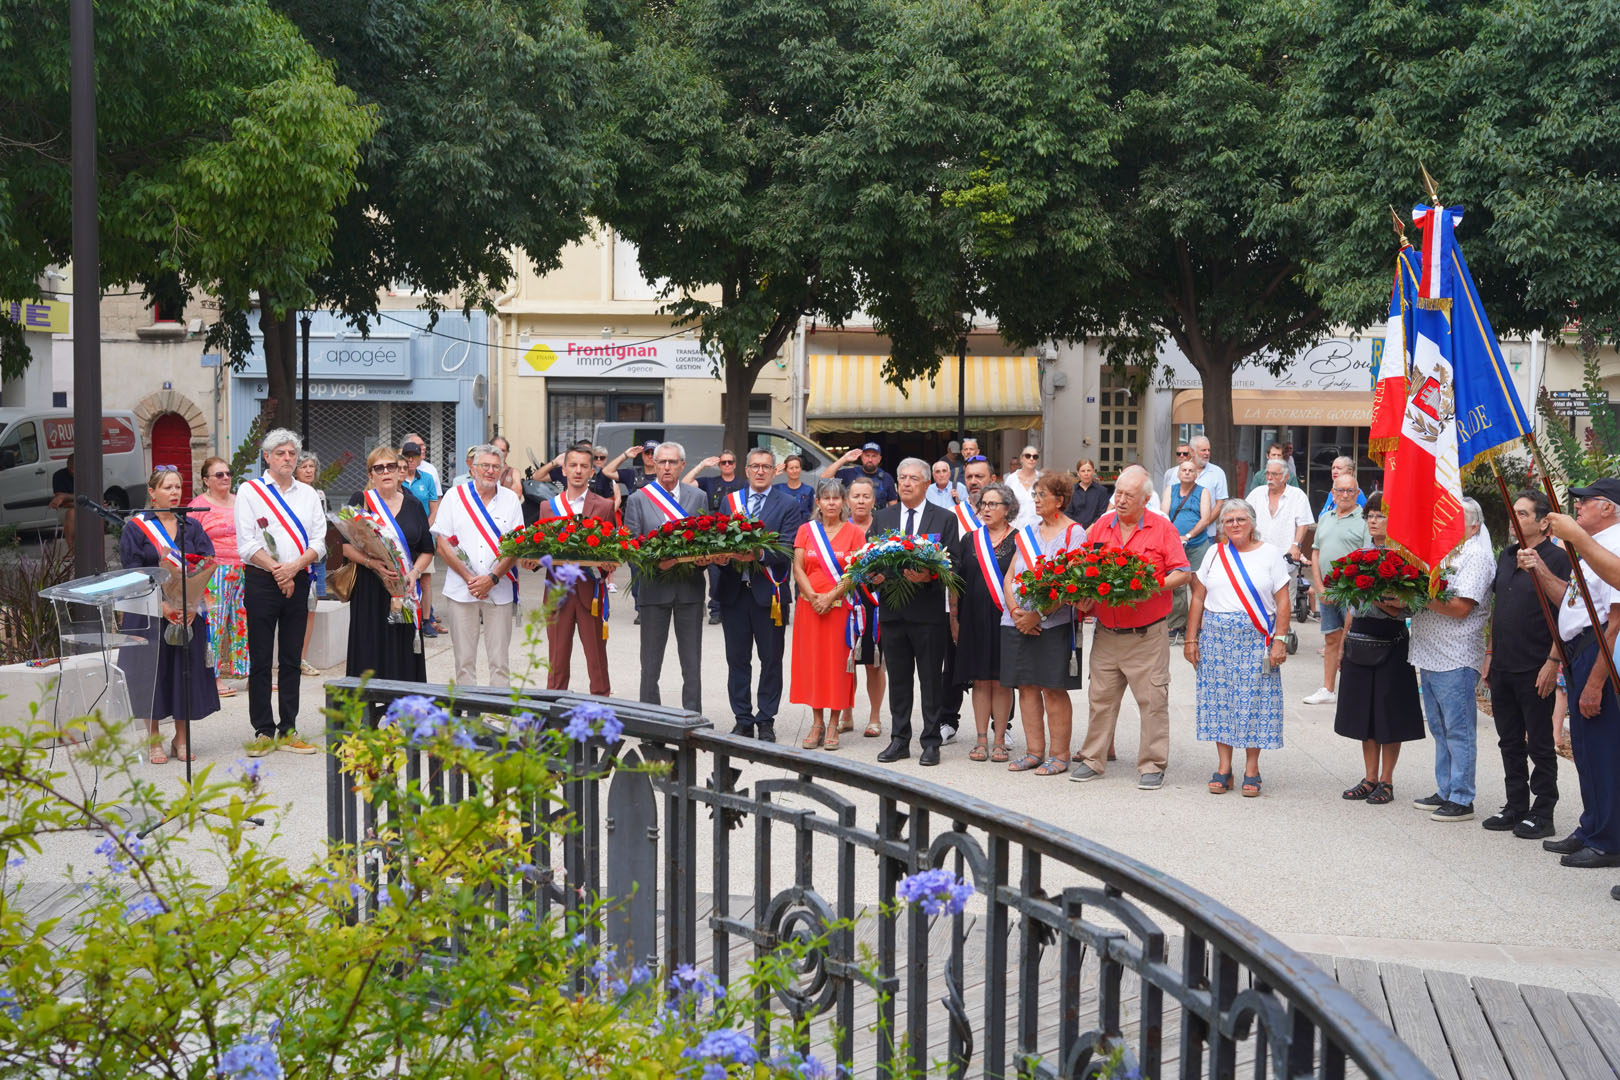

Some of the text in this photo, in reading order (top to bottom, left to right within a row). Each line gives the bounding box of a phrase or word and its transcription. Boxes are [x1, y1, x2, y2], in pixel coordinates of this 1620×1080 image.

[326, 346, 397, 367] apogée
[567, 342, 657, 360] Frontignan
[1303, 341, 1372, 374] Bou
[576, 357, 612, 366] immo
[627, 366, 653, 374] agence
[257, 384, 263, 392] &
[296, 380, 366, 397] sop yoga
[1326, 408, 1371, 420] GOURM
[853, 418, 903, 430] FRUITS
[907, 417, 925, 430] ET
[57, 423, 75, 441] RU
